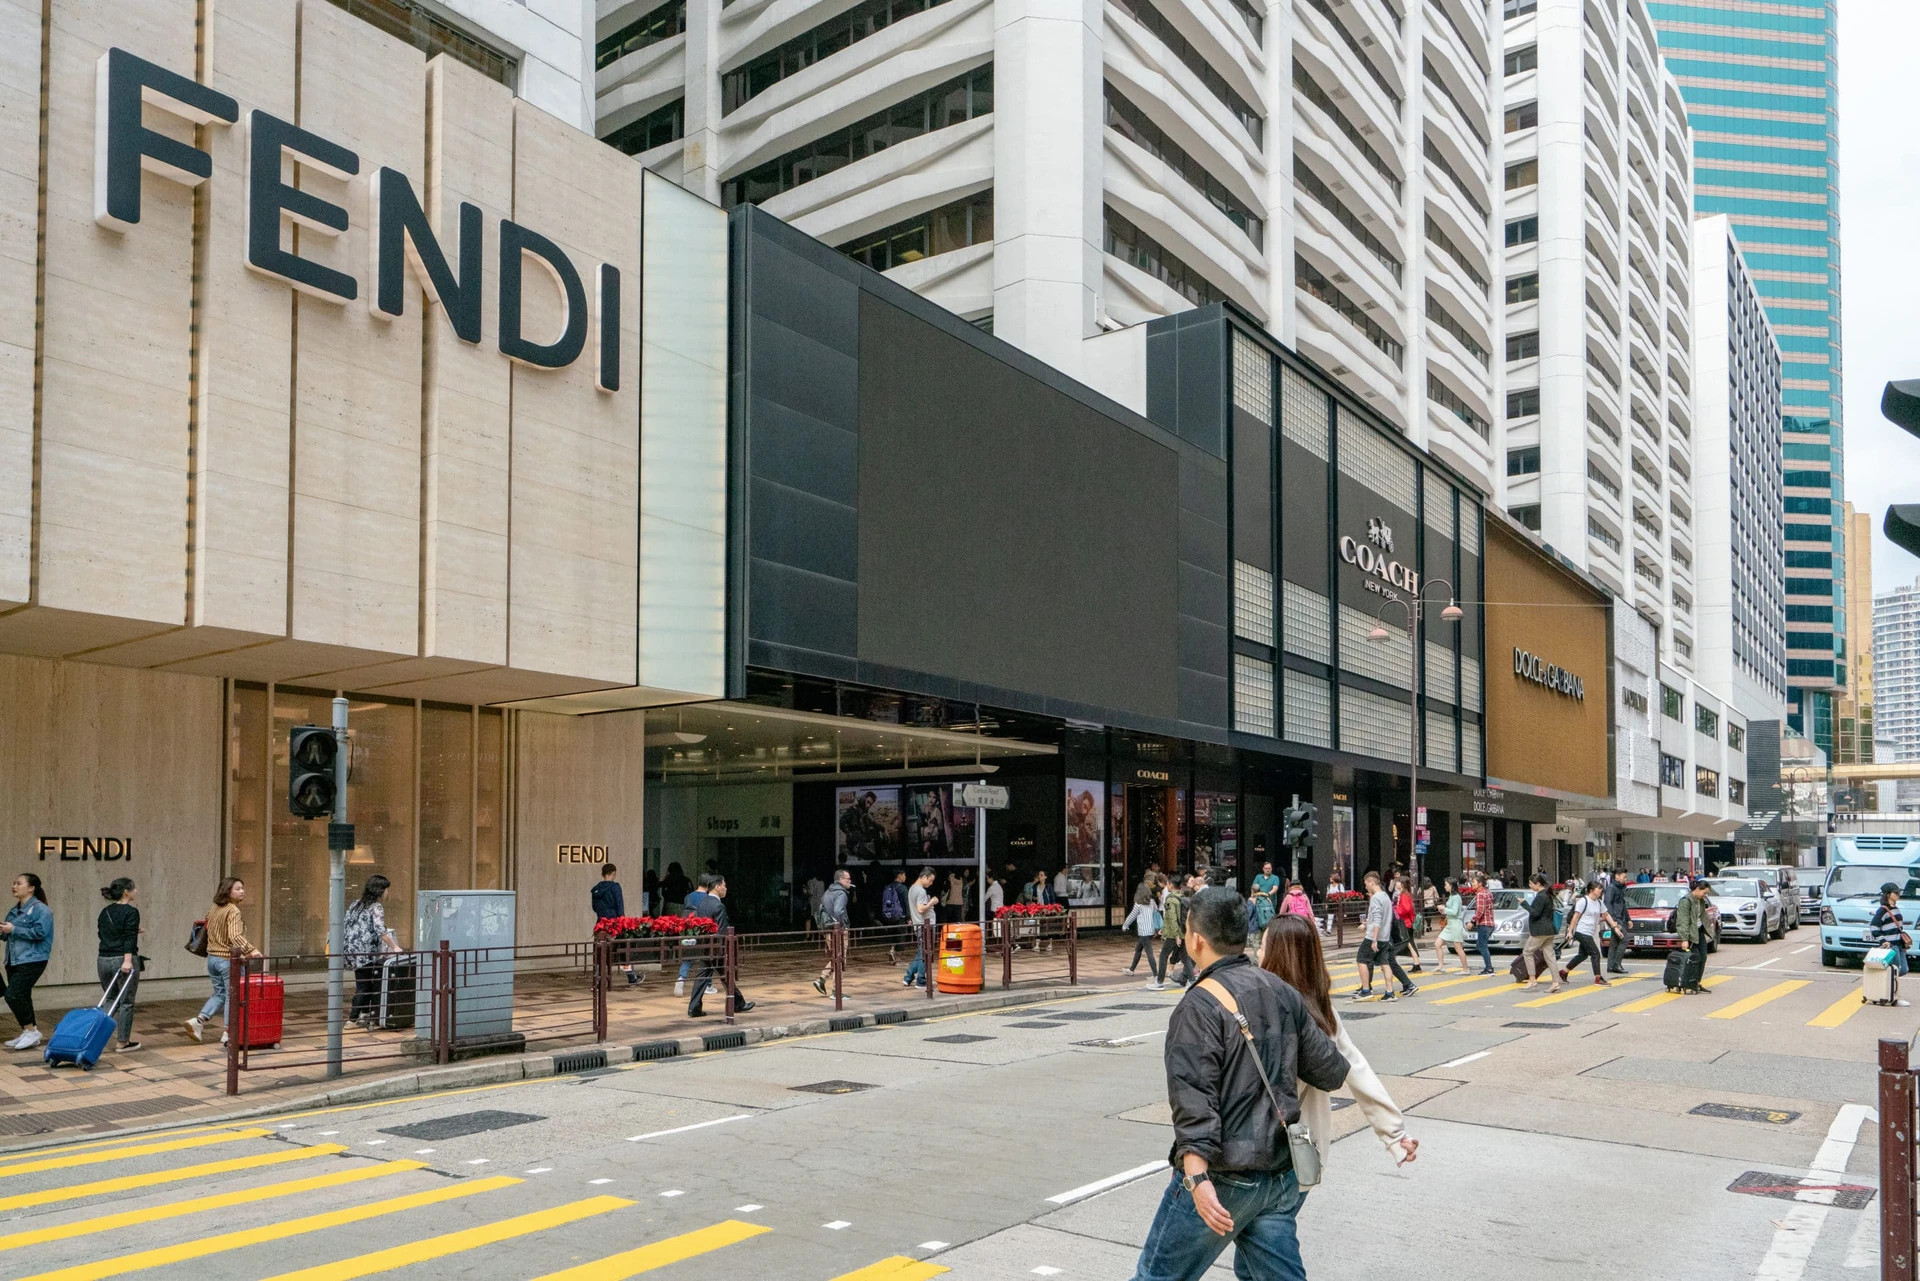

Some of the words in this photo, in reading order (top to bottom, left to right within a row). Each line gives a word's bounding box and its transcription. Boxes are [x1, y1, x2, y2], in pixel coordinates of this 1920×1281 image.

[96, 47, 621, 393] FENDI
[1340, 535, 1419, 596] COACH
[1363, 579, 1381, 594] NEW
[1382, 586, 1399, 601] YORK
[1136, 769, 1169, 781] COACH
[707, 816, 740, 833] Shops
[39, 836, 132, 861] FENDI
[558, 845, 609, 864] FENDI
